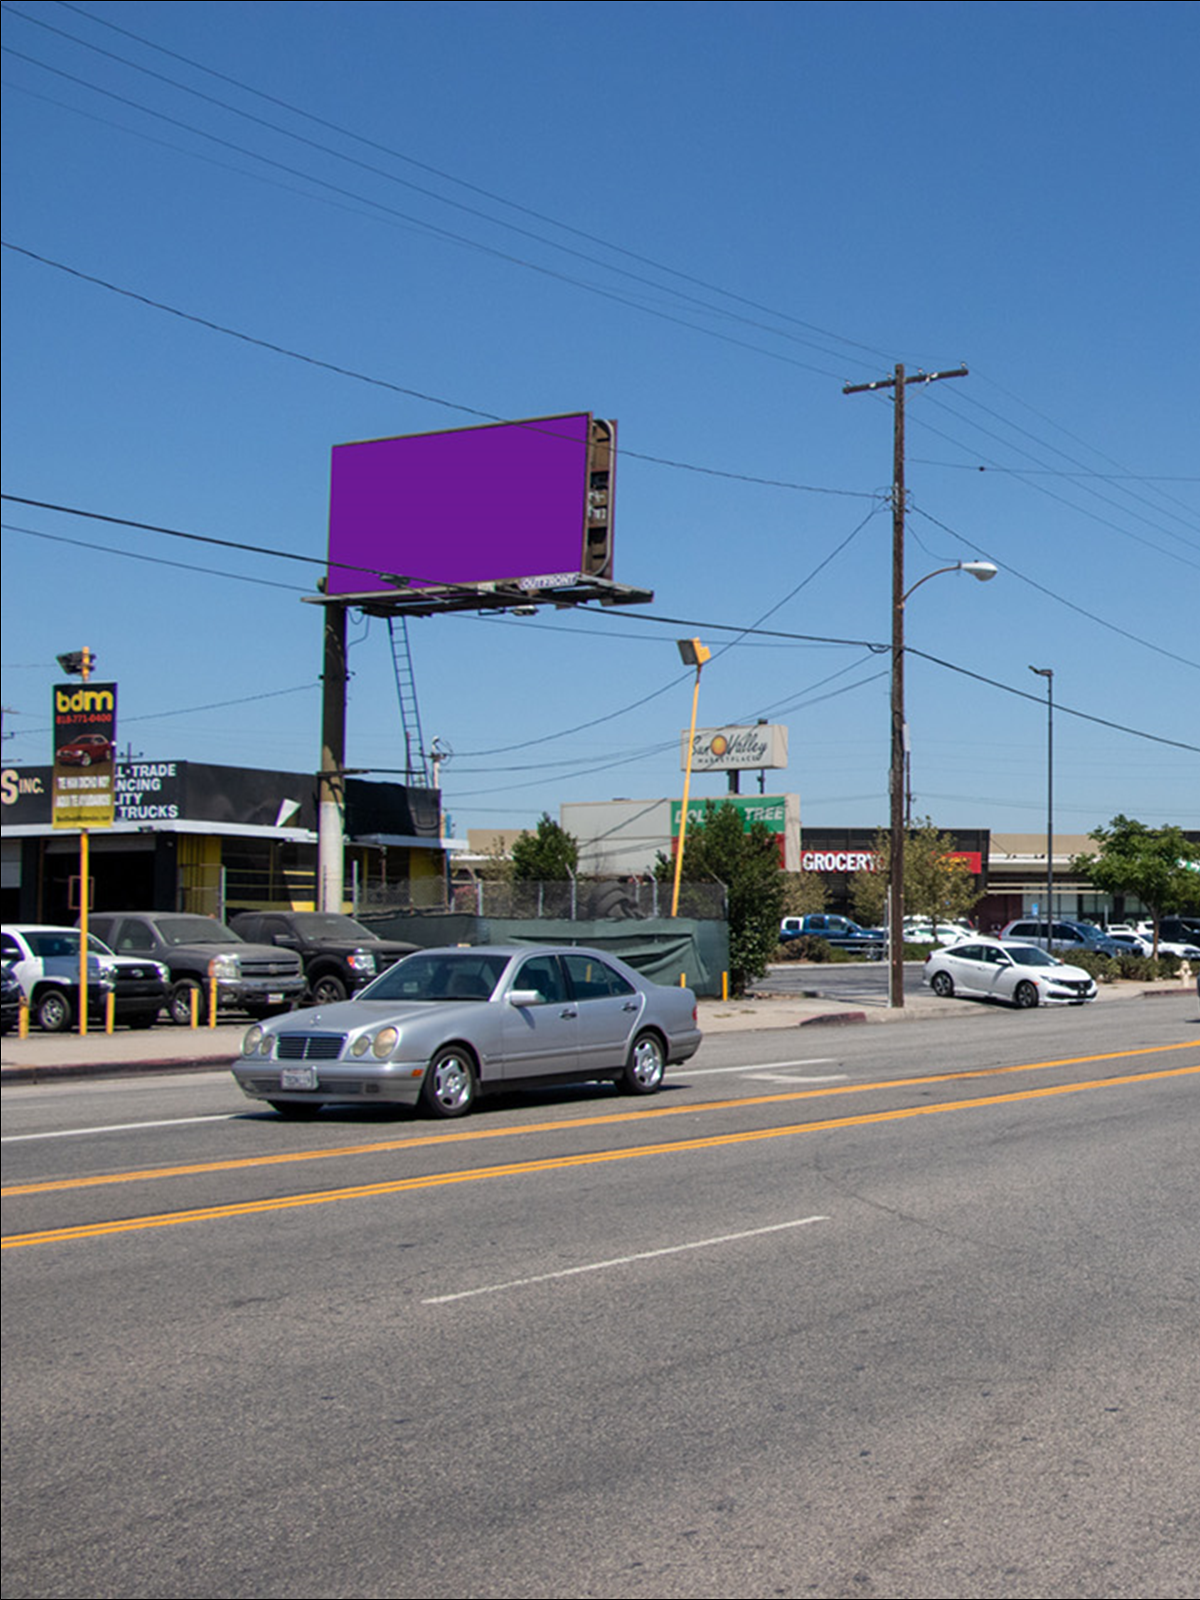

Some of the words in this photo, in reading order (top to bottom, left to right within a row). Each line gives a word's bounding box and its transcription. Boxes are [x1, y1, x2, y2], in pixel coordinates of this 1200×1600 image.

[56, 690, 114, 712] bdm
[726, 732, 768, 756] Valley
[19, 777, 45, 794] INC.
[119, 804, 179, 819] TRUCKS
[744, 807, 784, 821] TREE
[802, 852, 877, 872] GROCERY
